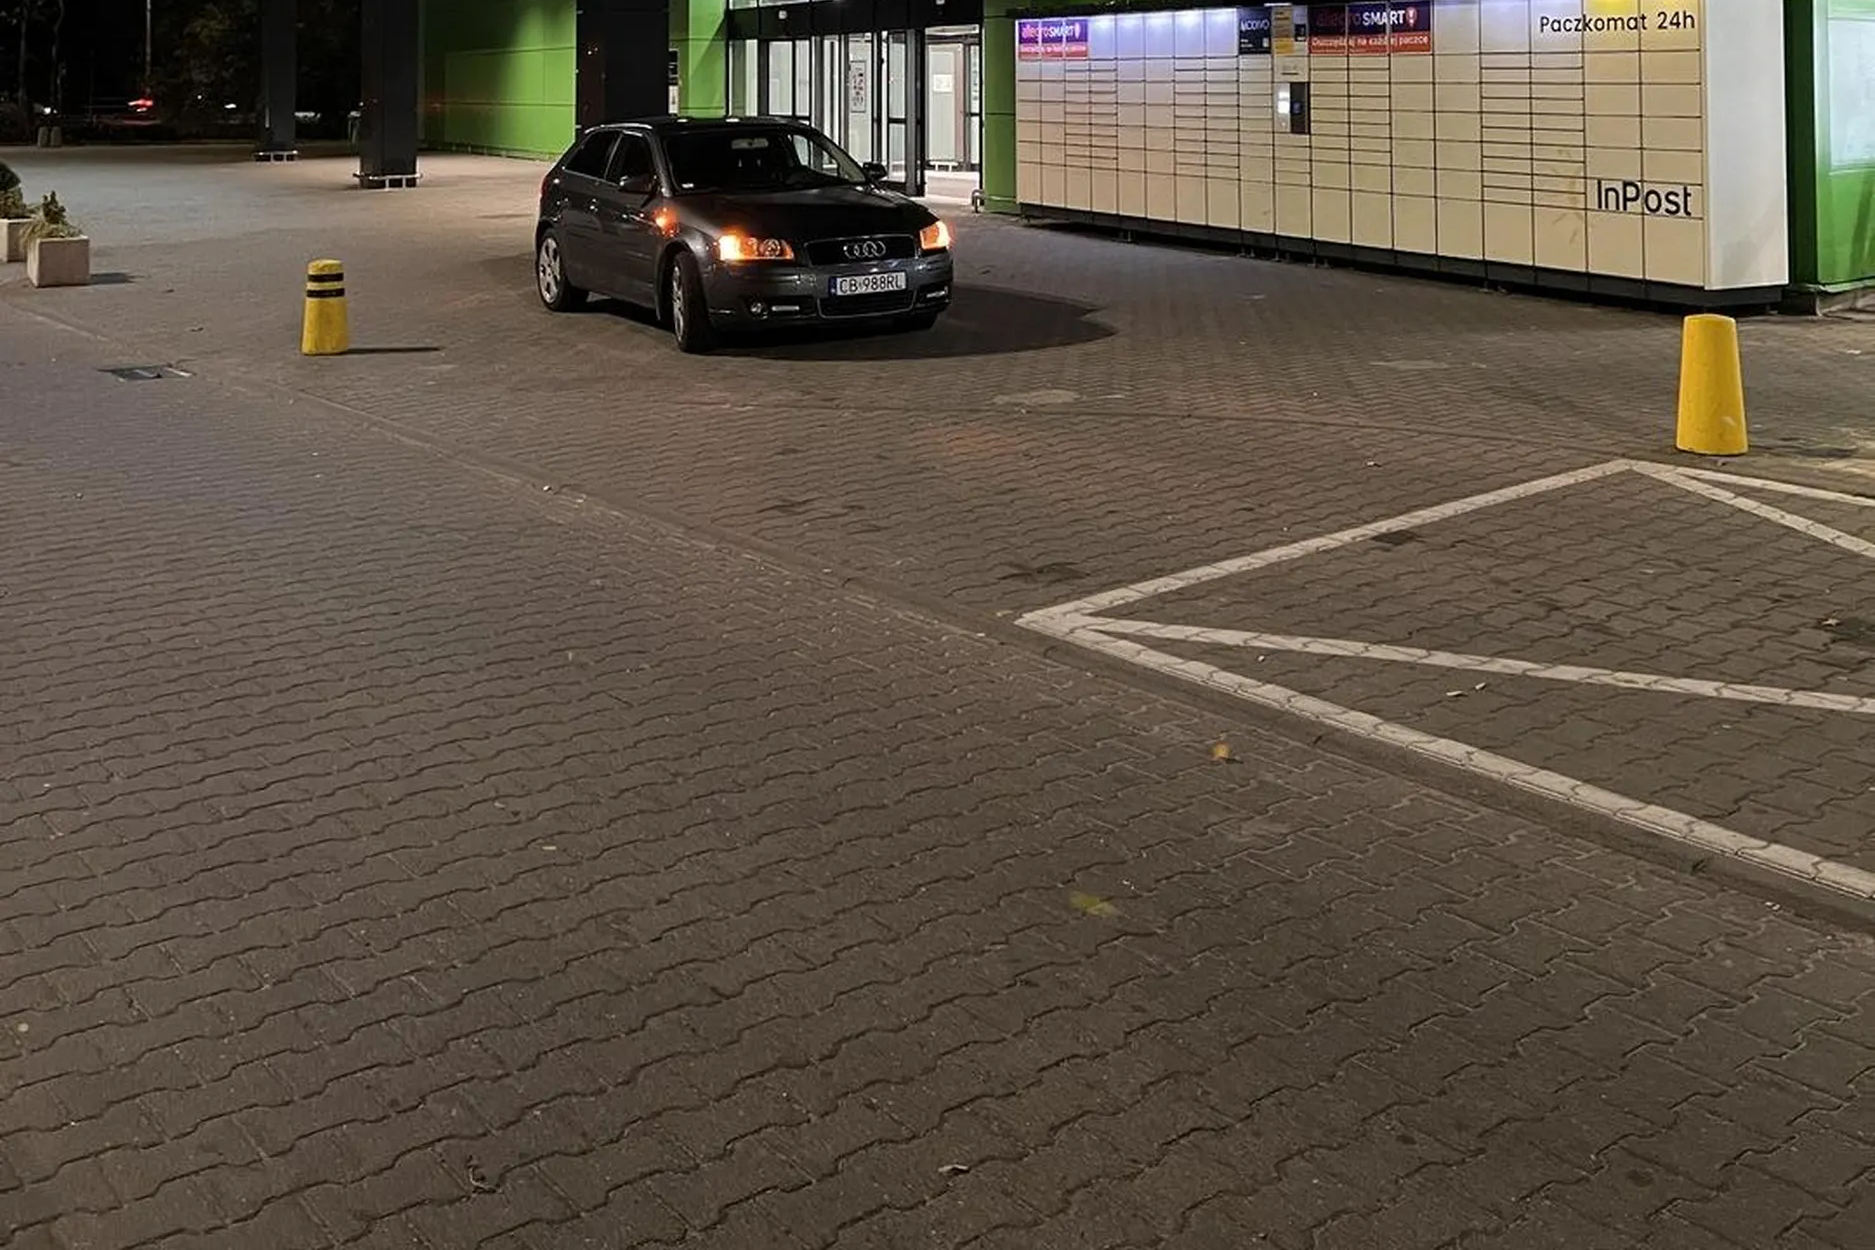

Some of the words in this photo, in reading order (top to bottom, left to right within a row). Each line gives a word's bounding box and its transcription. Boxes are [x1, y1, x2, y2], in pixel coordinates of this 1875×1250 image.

[1540, 13, 1647, 33] Paczkomat
[1657, 10, 1696, 30] 24h
[1597, 179, 1692, 216] InPost
